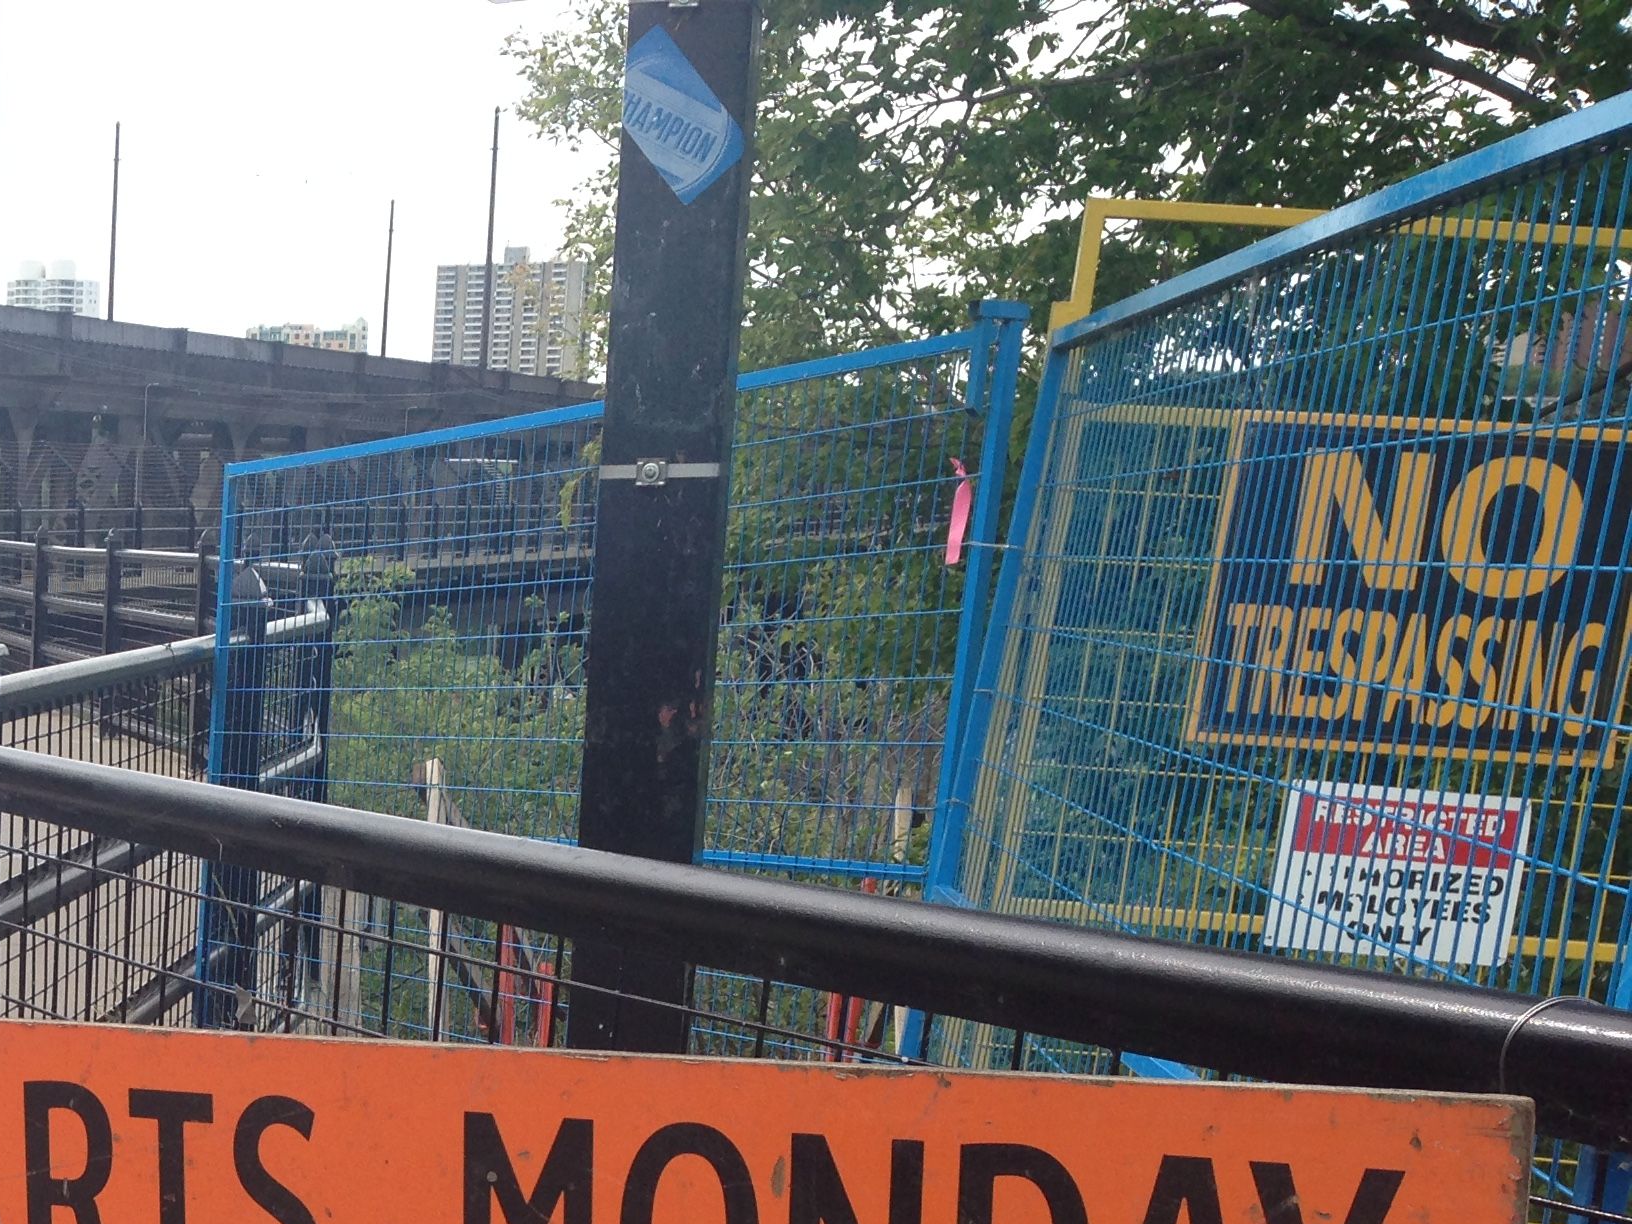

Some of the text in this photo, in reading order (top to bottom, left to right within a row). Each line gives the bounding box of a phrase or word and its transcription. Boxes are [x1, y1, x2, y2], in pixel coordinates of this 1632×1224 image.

[623, 90, 718, 162] HAMPION
[1289, 447, 1584, 599] NO
[1226, 602, 1608, 736] TRESPASSING
[1314, 799, 1506, 837] RESTRICTED
[1361, 831, 1446, 860] AREA
[1345, 920, 1432, 946] ONLY
